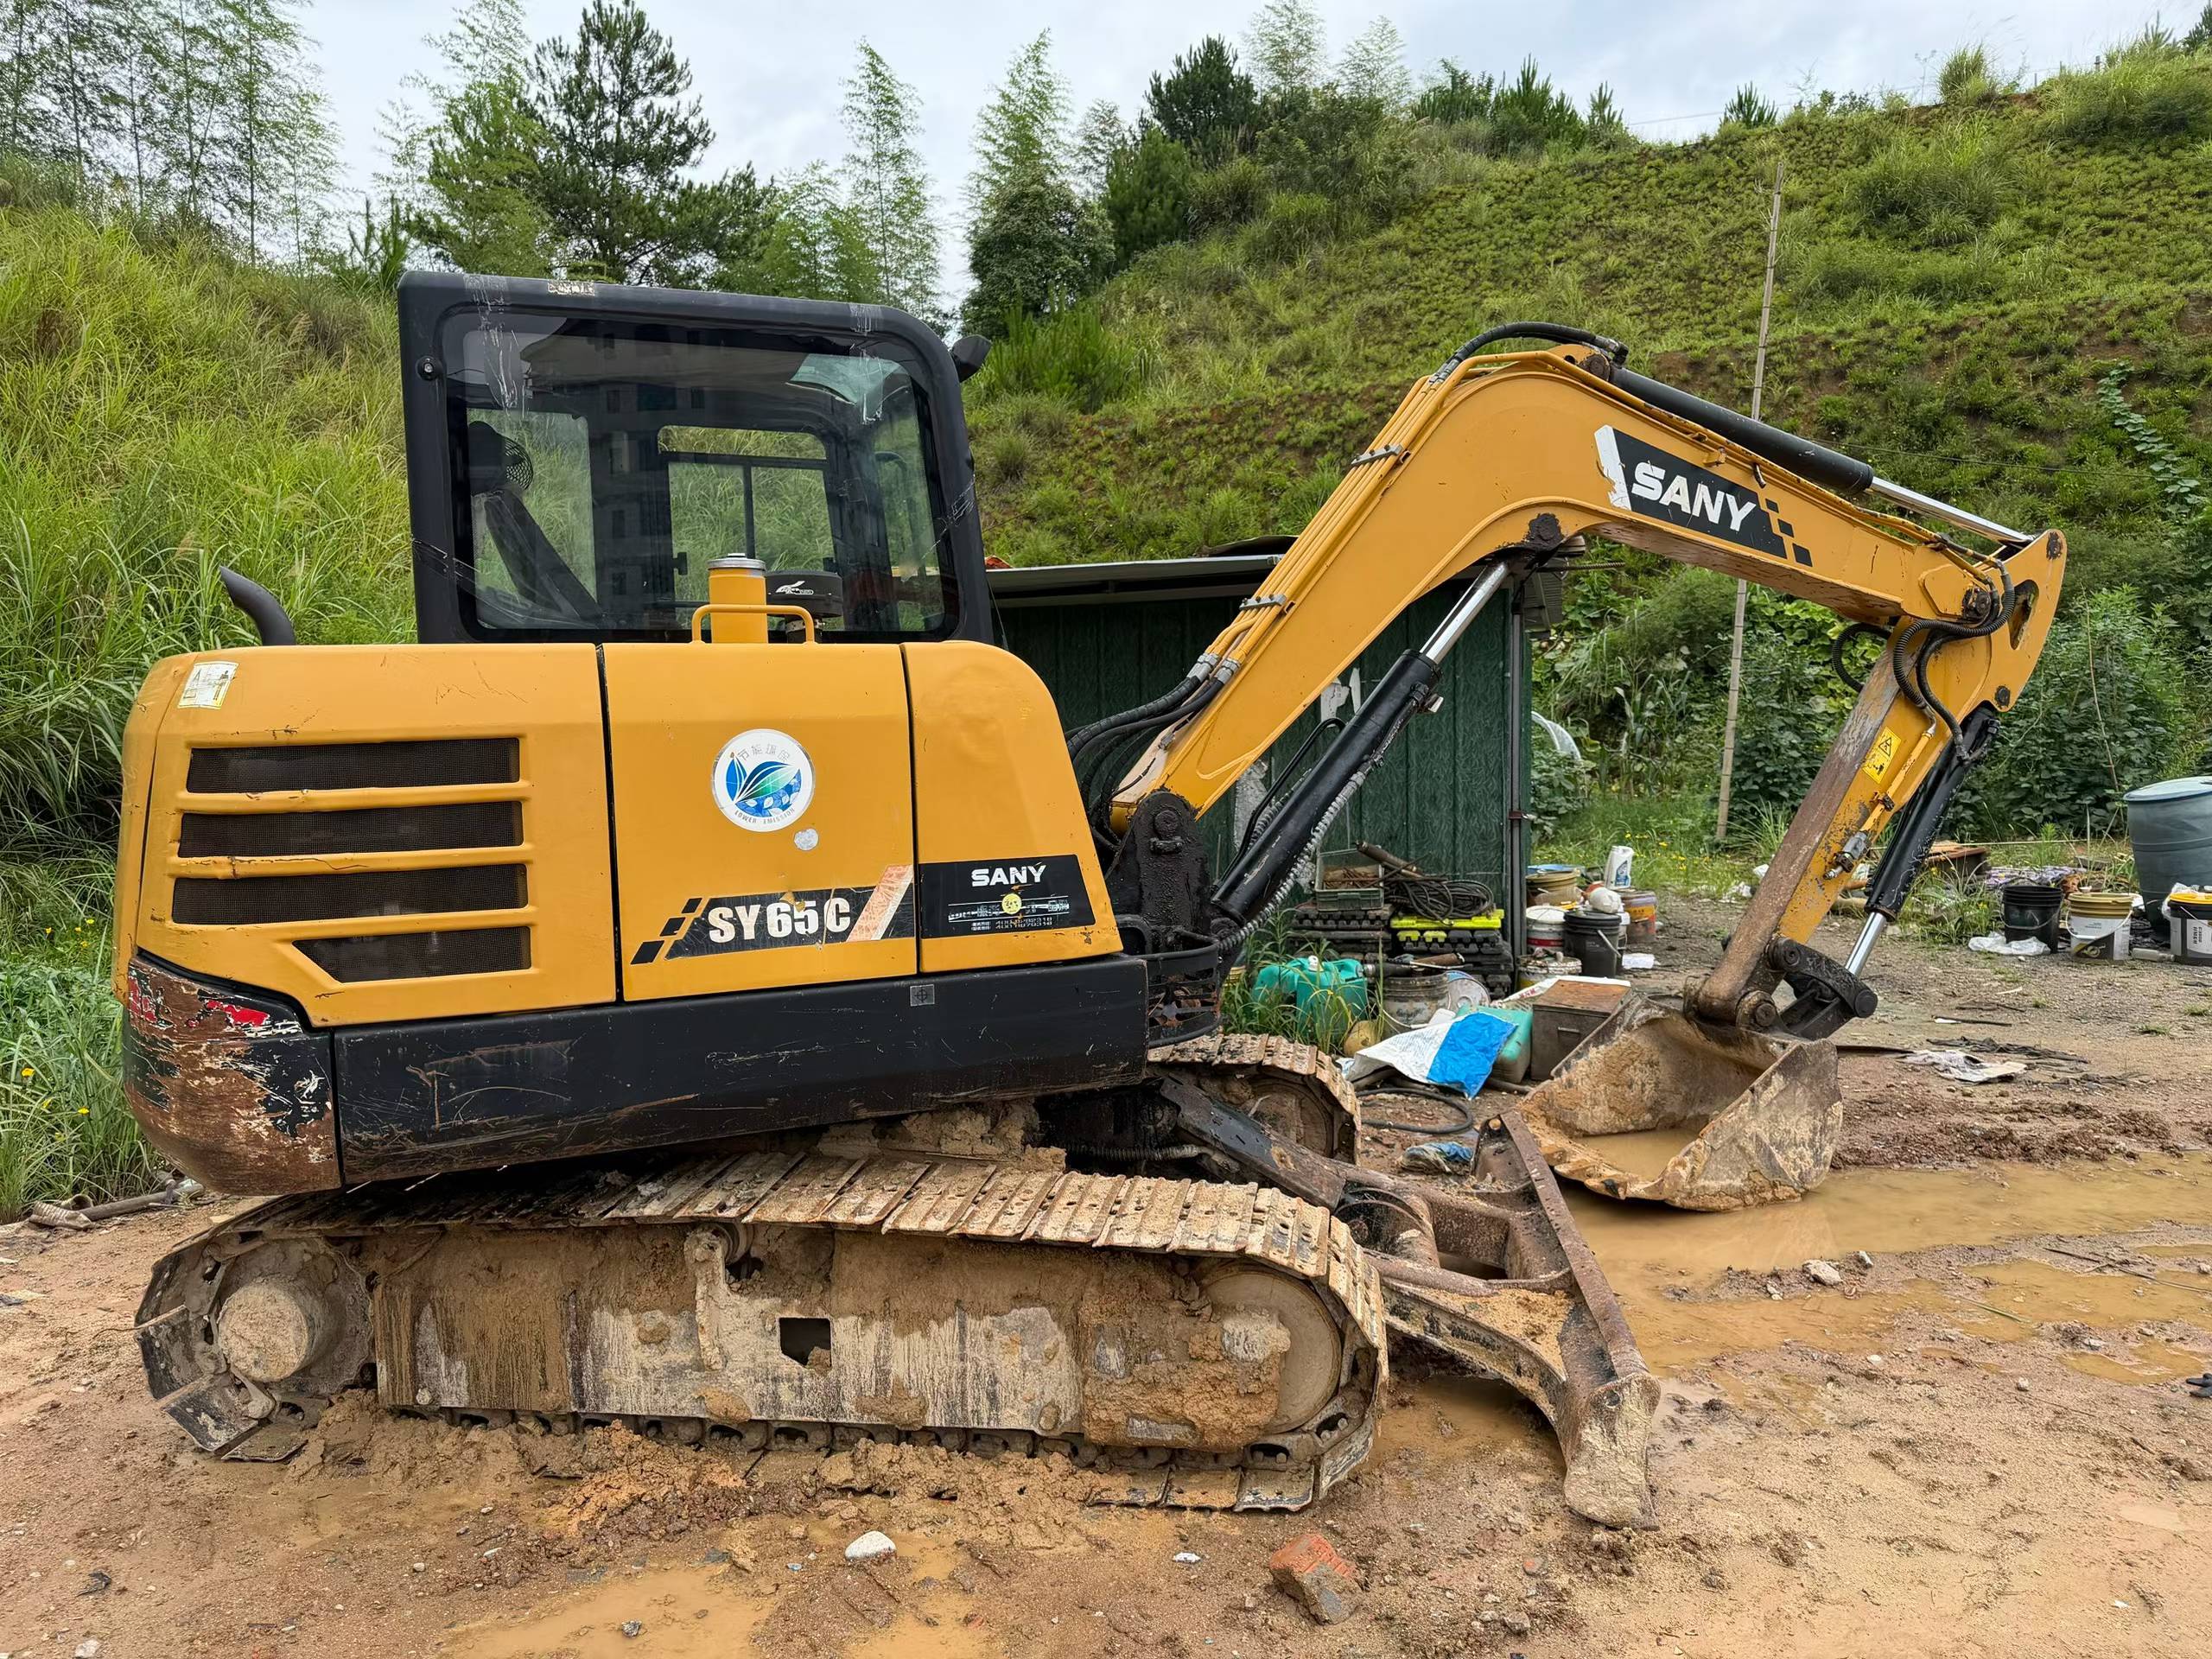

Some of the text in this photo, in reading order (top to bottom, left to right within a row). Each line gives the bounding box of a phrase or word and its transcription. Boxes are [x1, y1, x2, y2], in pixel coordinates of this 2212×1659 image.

[1631, 461, 1757, 532] SANY
[971, 864, 1047, 887] SANY
[708, 897, 851, 944] SY65C
